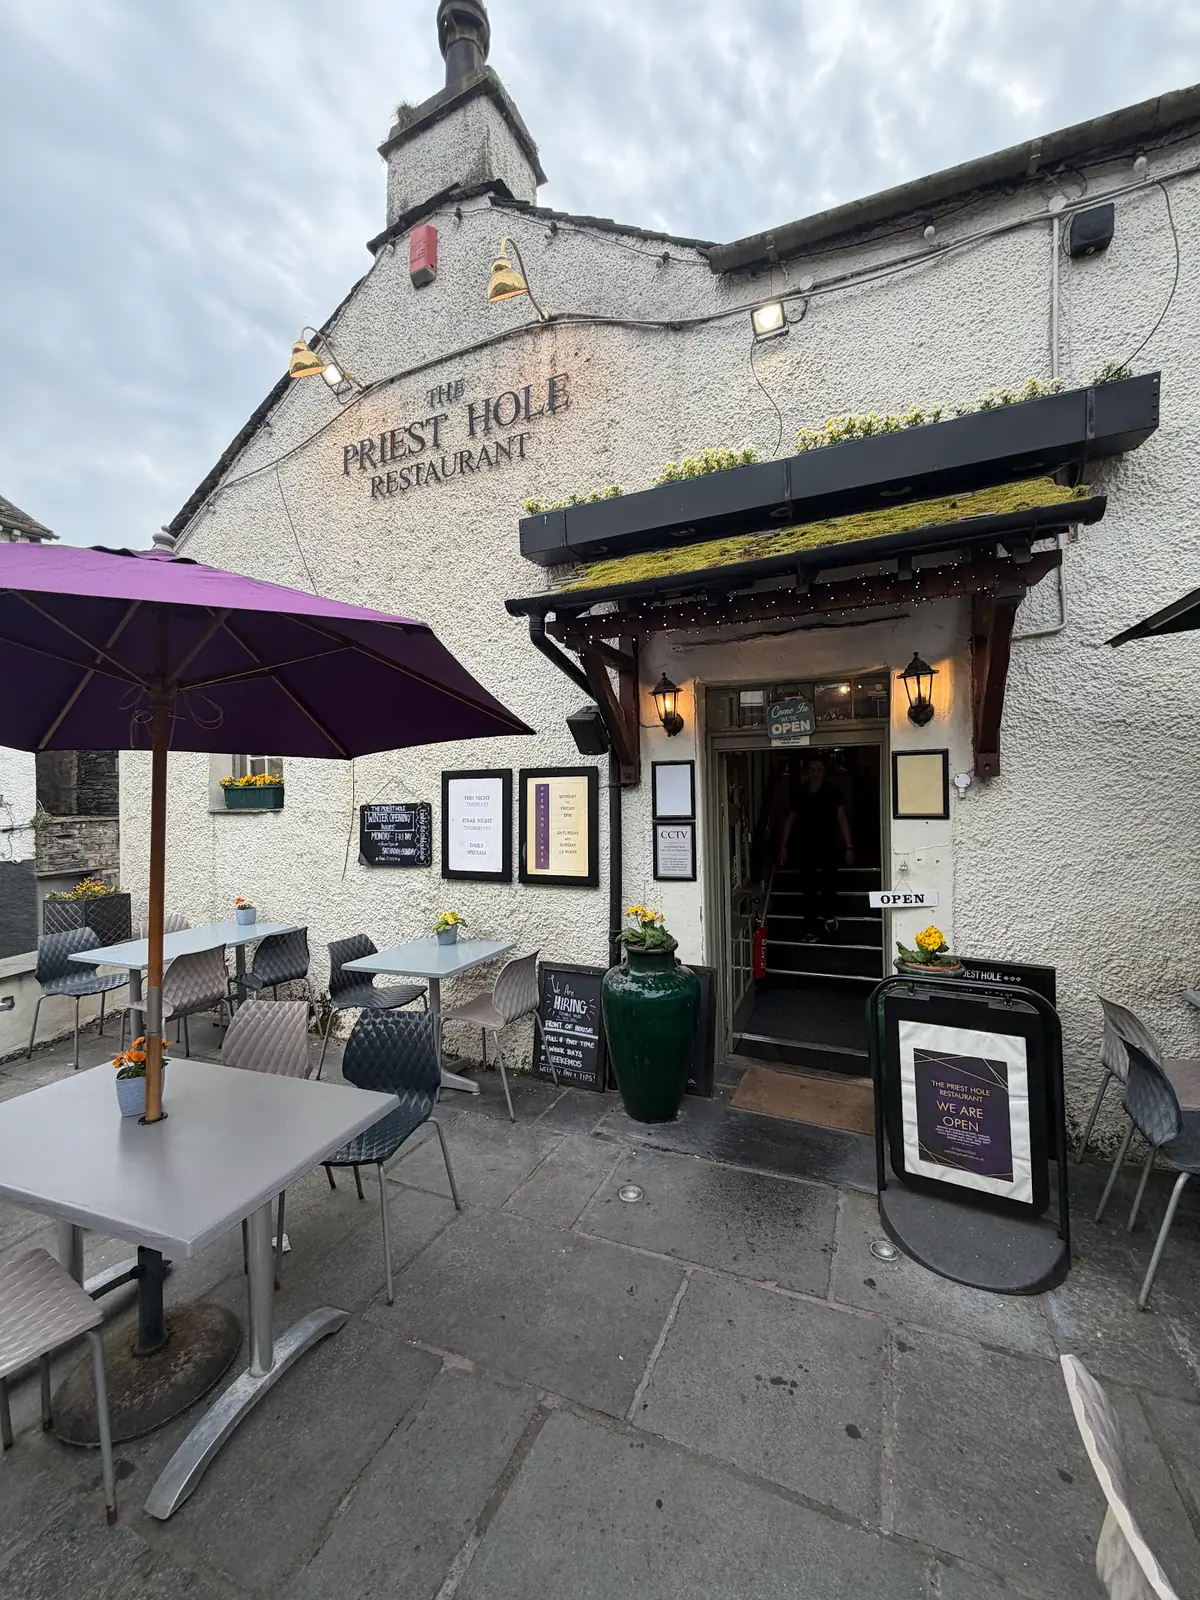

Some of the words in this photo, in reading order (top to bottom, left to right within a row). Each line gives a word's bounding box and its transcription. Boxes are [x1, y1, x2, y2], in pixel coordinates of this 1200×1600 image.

[427, 379, 464, 408] THE
[341, 412, 449, 475] PRIEST
[467, 372, 570, 437] HOLE
[371, 432, 530, 498] RESTAURANT
[772, 706, 794, 718] Come
[796, 702, 809, 714] In
[771, 720, 811, 735] OPEN
[368, 812, 389, 823] WINTER
[660, 830, 688, 839] CCTV
[880, 894, 925, 905] OPEN
[981, 971, 1003, 981] HOLE
[553, 995, 588, 1015] HIRING
[545, 1020, 563, 1029] FRONT
[575, 1025, 594, 1034] HOUSE
[546, 1034, 559, 1043] FULL
[580, 1041, 596, 1049] TIME
[567, 1049, 583, 1058] DAYS
[930, 1080, 945, 1089] THE
[946, 1083, 968, 1092] PRIEST
[970, 1087, 991, 1097] HOLE
[939, 1090, 983, 1103] RESTAURANT
[936, 1101, 956, 1114] WE
[960, 1106, 984, 1119] ARE
[943, 1116, 979, 1132] OPEN
